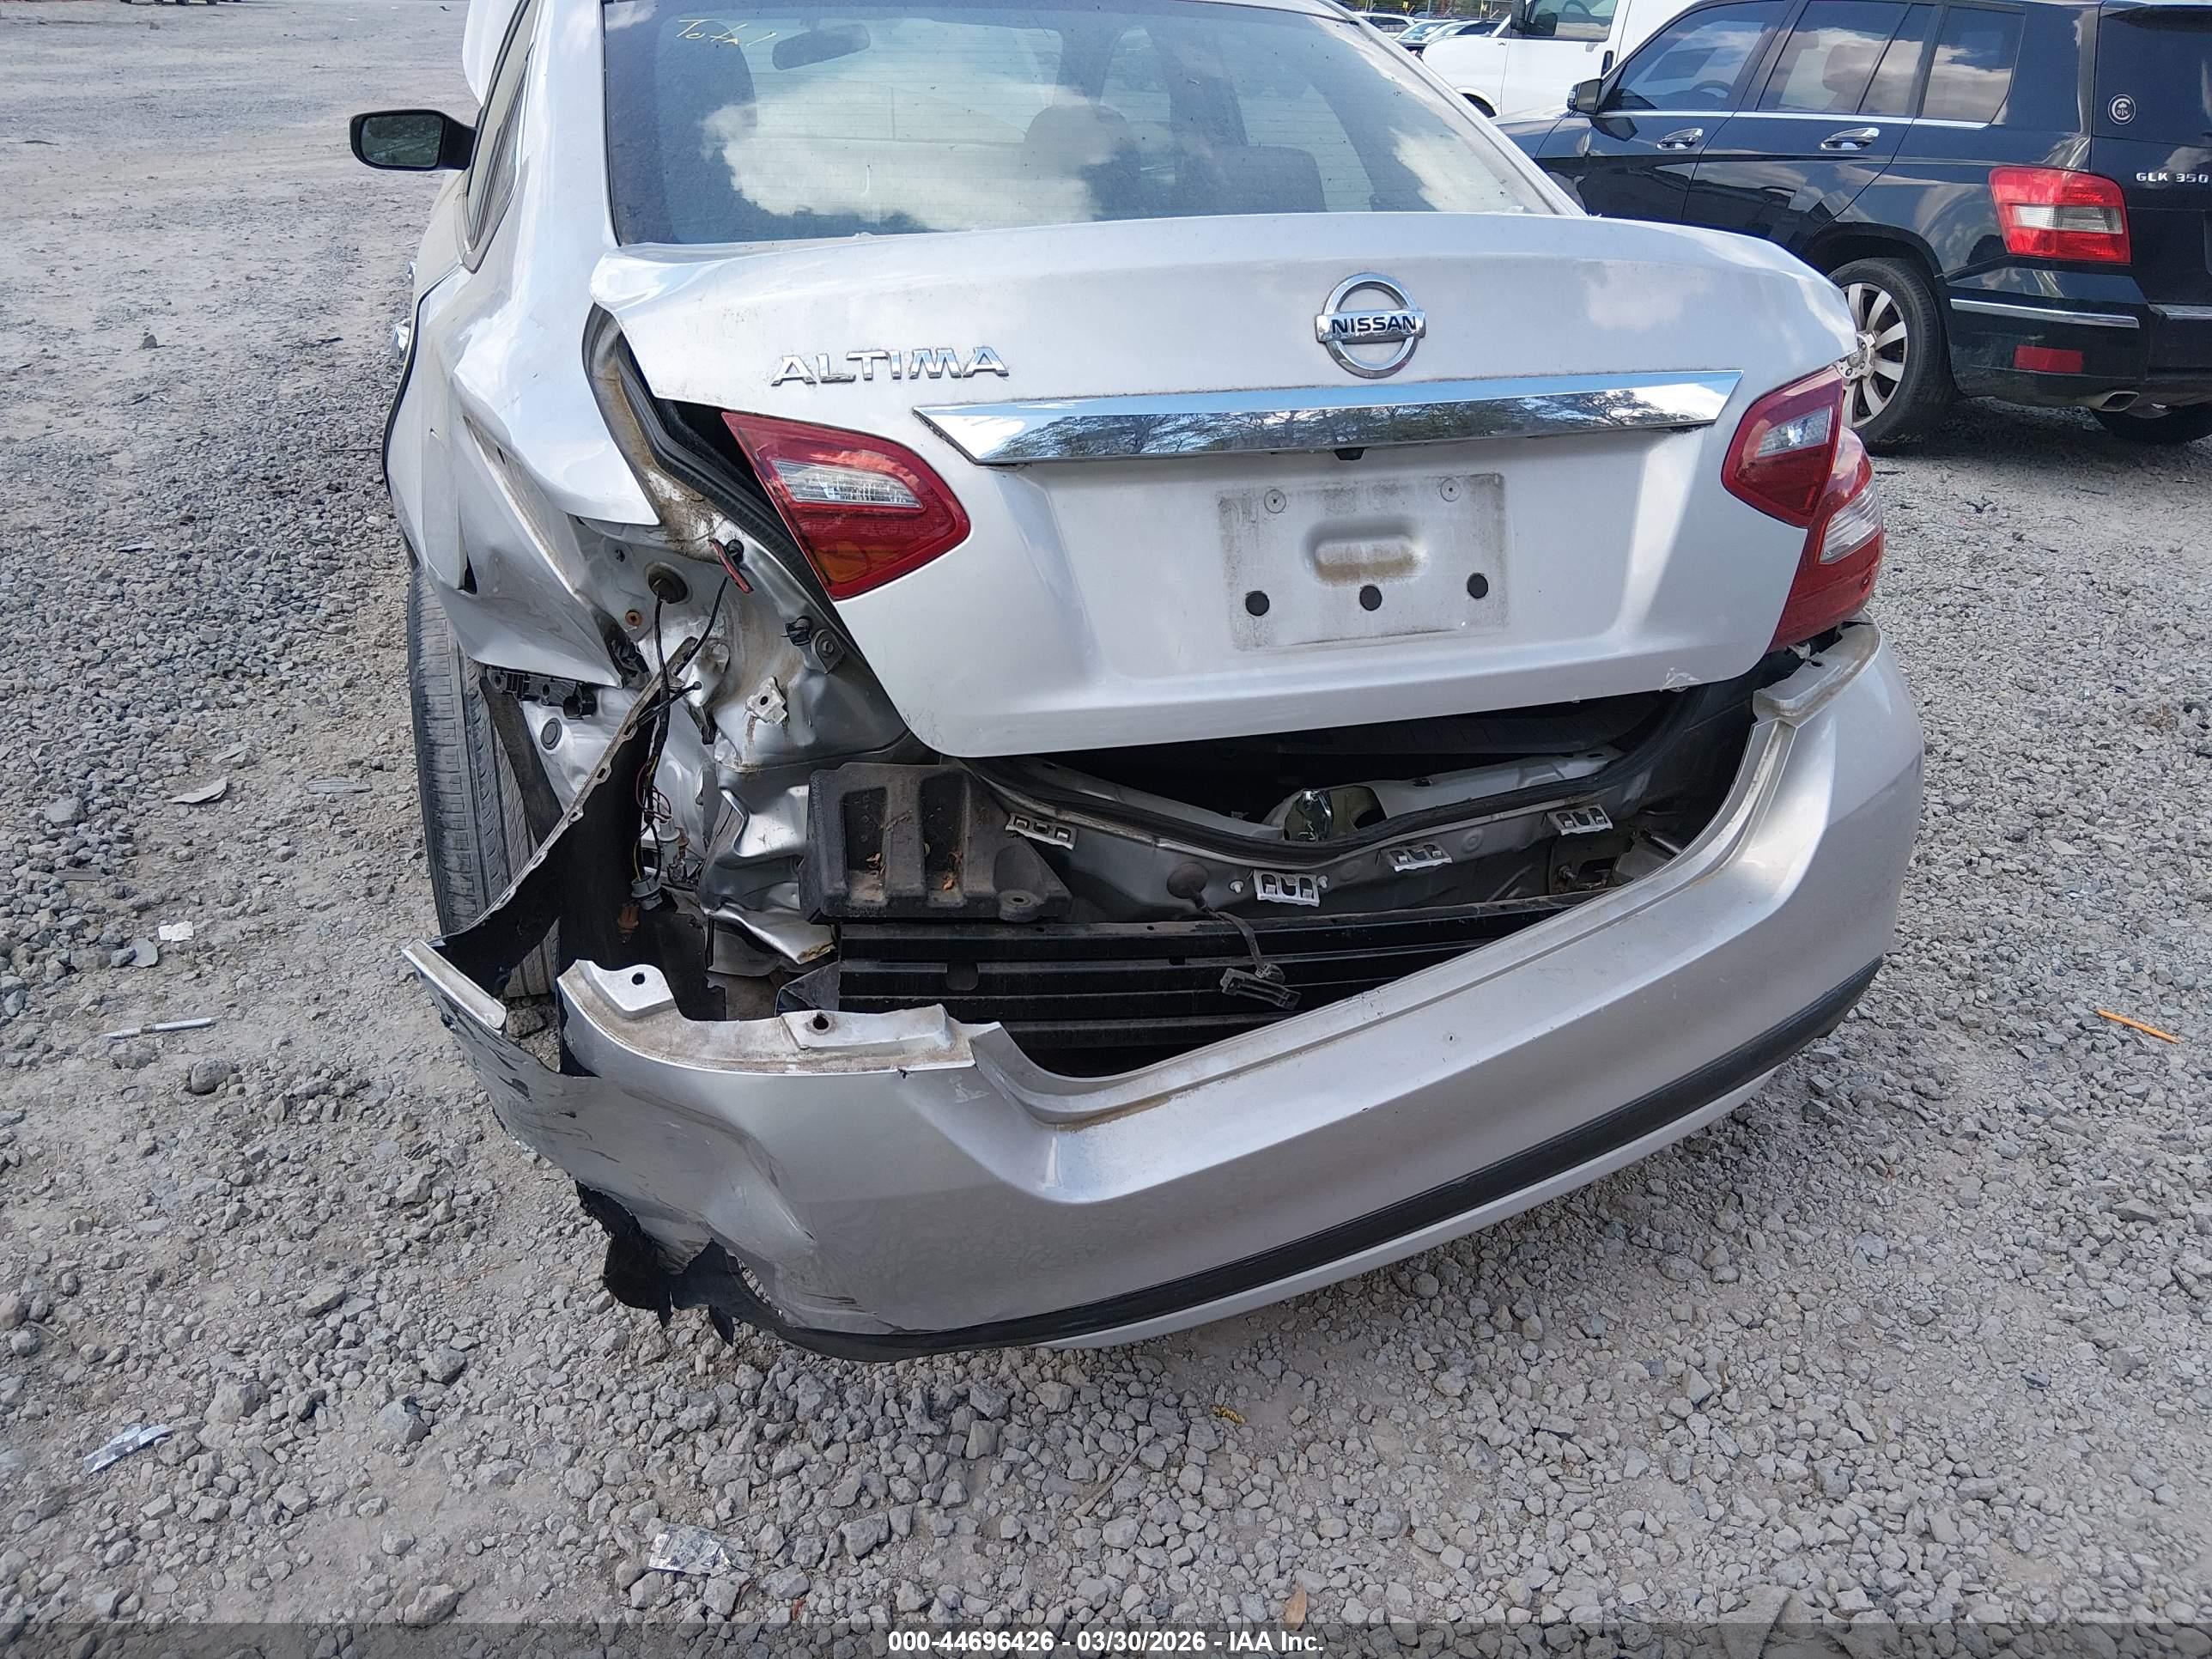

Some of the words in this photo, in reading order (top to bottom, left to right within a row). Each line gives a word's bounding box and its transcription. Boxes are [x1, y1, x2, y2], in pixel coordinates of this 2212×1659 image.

[2136, 172, 2168, 182] GLK
[2175, 173, 2209, 184] 350
[1331, 315, 1417, 334] NISSAN
[770, 346, 1010, 386] ALTIMA
